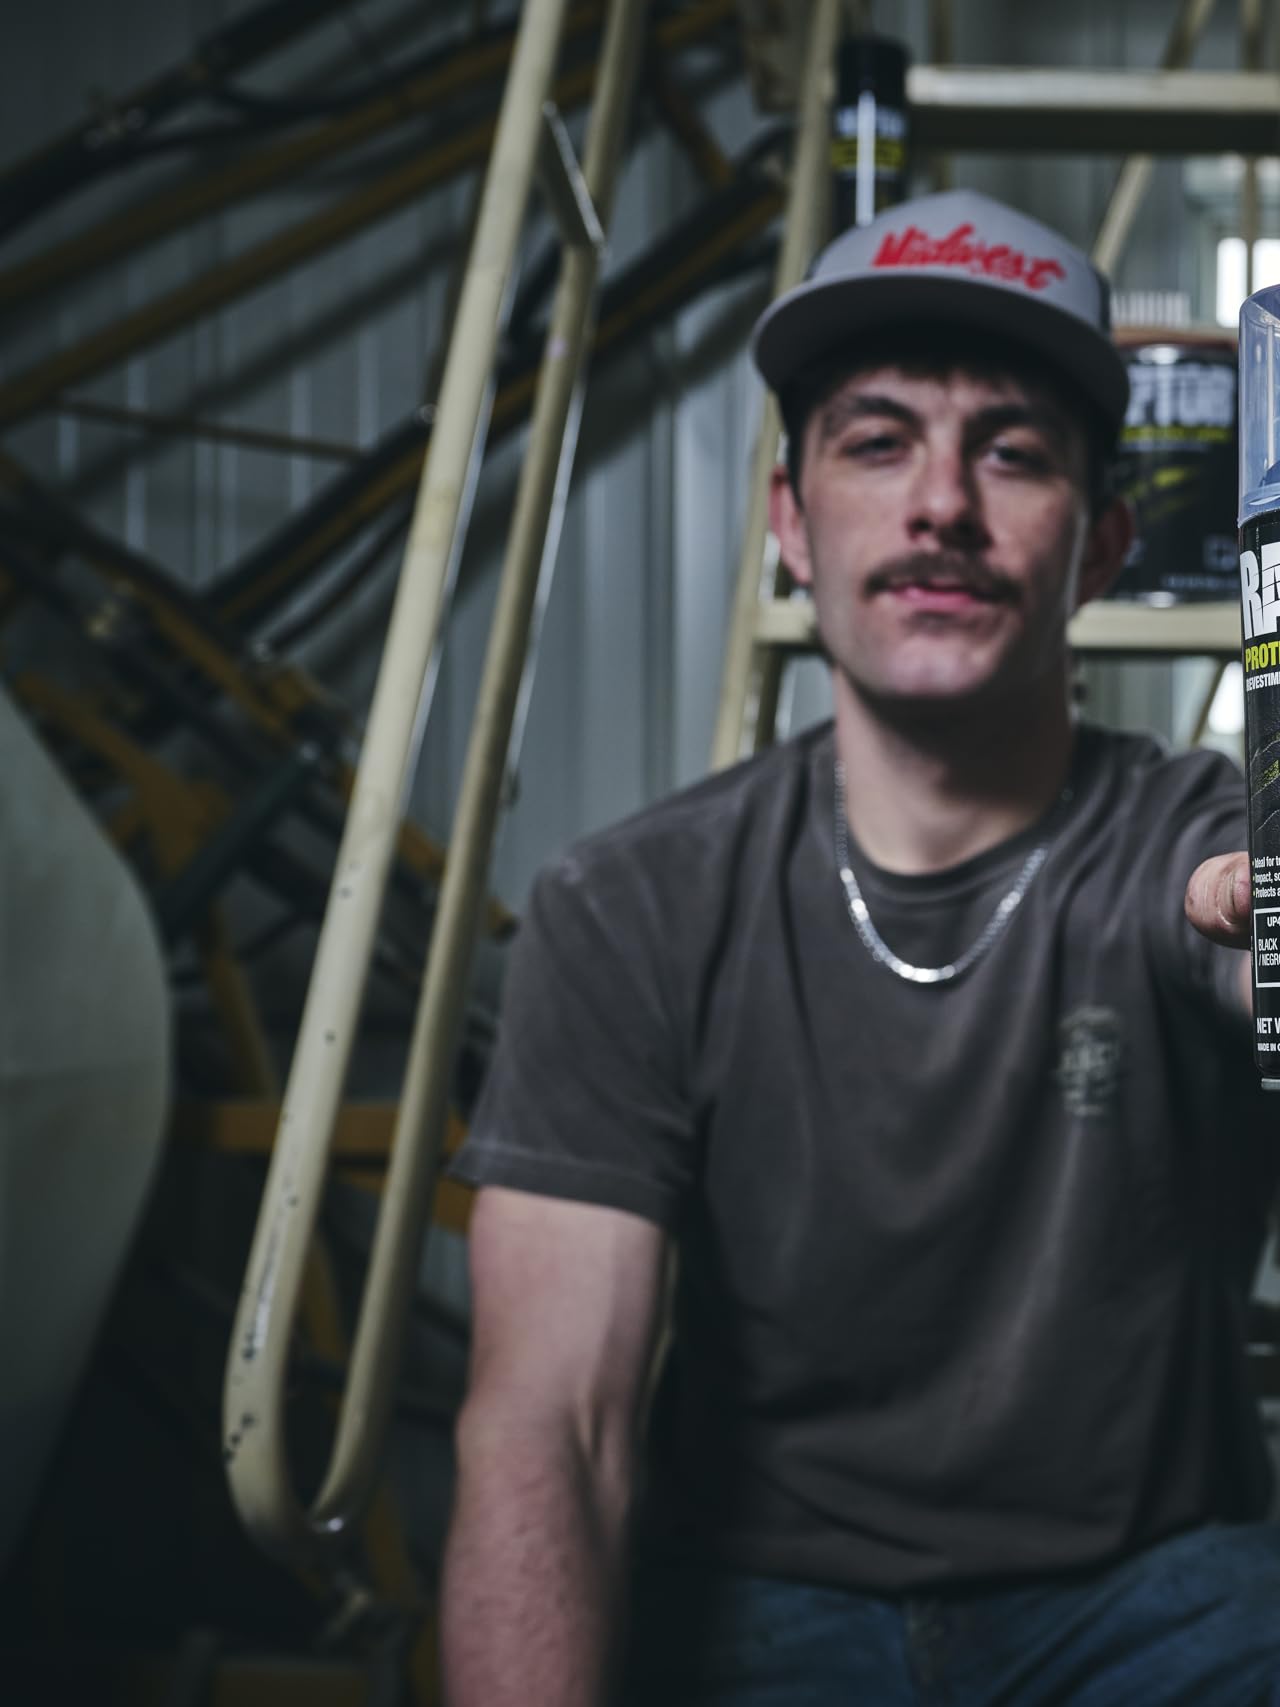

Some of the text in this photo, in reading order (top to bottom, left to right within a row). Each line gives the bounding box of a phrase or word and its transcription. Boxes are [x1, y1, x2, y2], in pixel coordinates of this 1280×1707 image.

[1266, 856, 1274, 867] for
[1256, 886, 1276, 899] Protects
[1258, 938, 1278, 952] BLACK
[1257, 1017, 1272, 1034] NET
